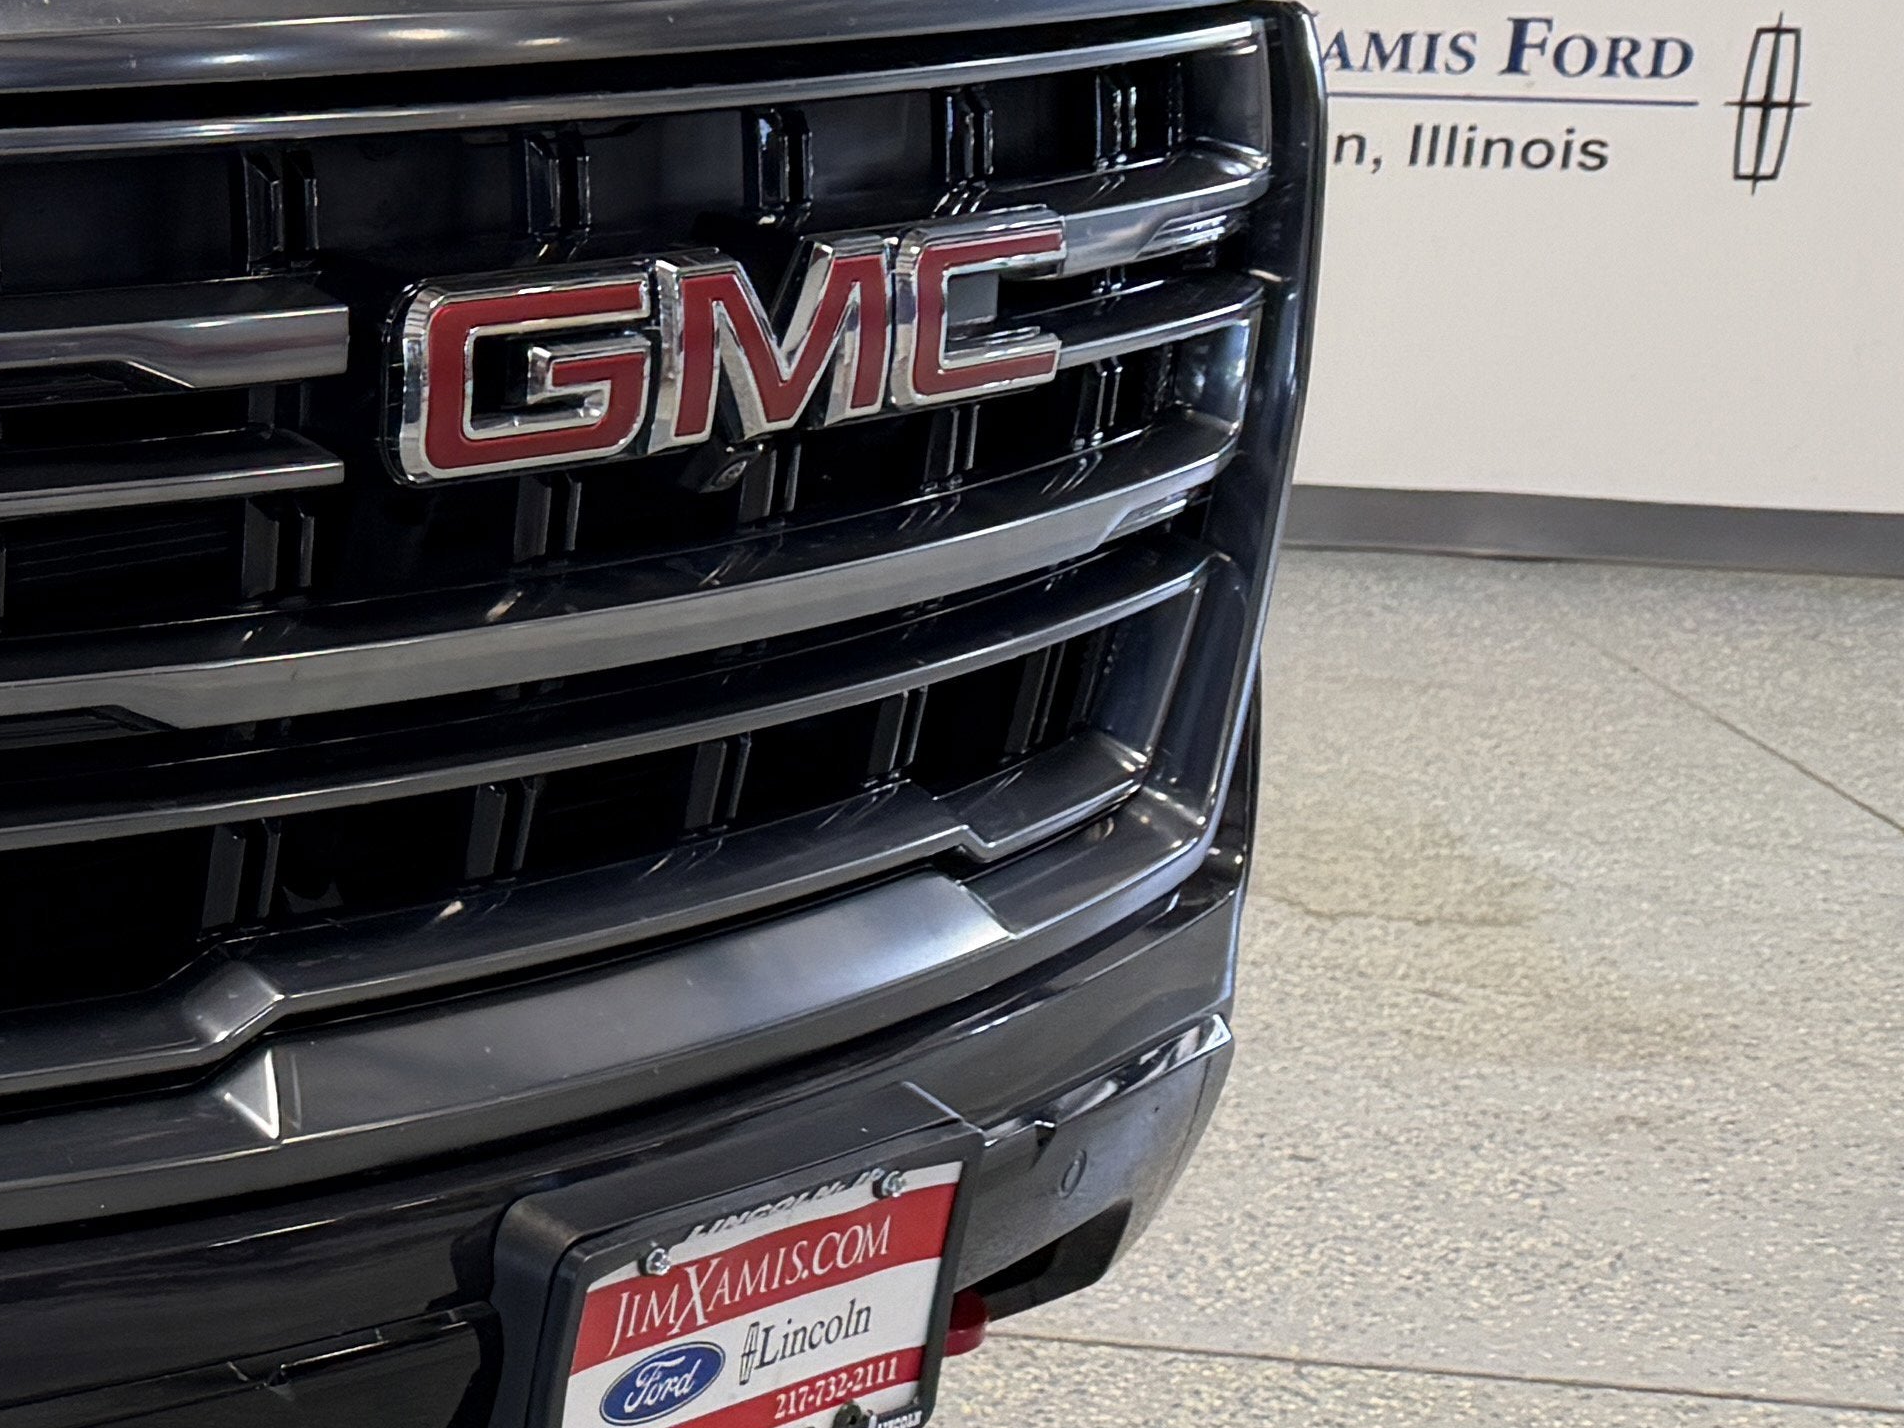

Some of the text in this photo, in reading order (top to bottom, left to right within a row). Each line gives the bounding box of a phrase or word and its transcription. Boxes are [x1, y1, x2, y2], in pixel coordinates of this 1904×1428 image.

[1322, 16, 1694, 80] AMIS FORD
[1407, 123, 1609, 172] Illinois
[394, 205, 1066, 484] GMC
[608, 1215, 893, 1357] JIMXAMIS.COM
[754, 1298, 872, 1371] Lincoln
[625, 1355, 701, 1412] Ford
[774, 1356, 898, 1420] 217-732-2111
